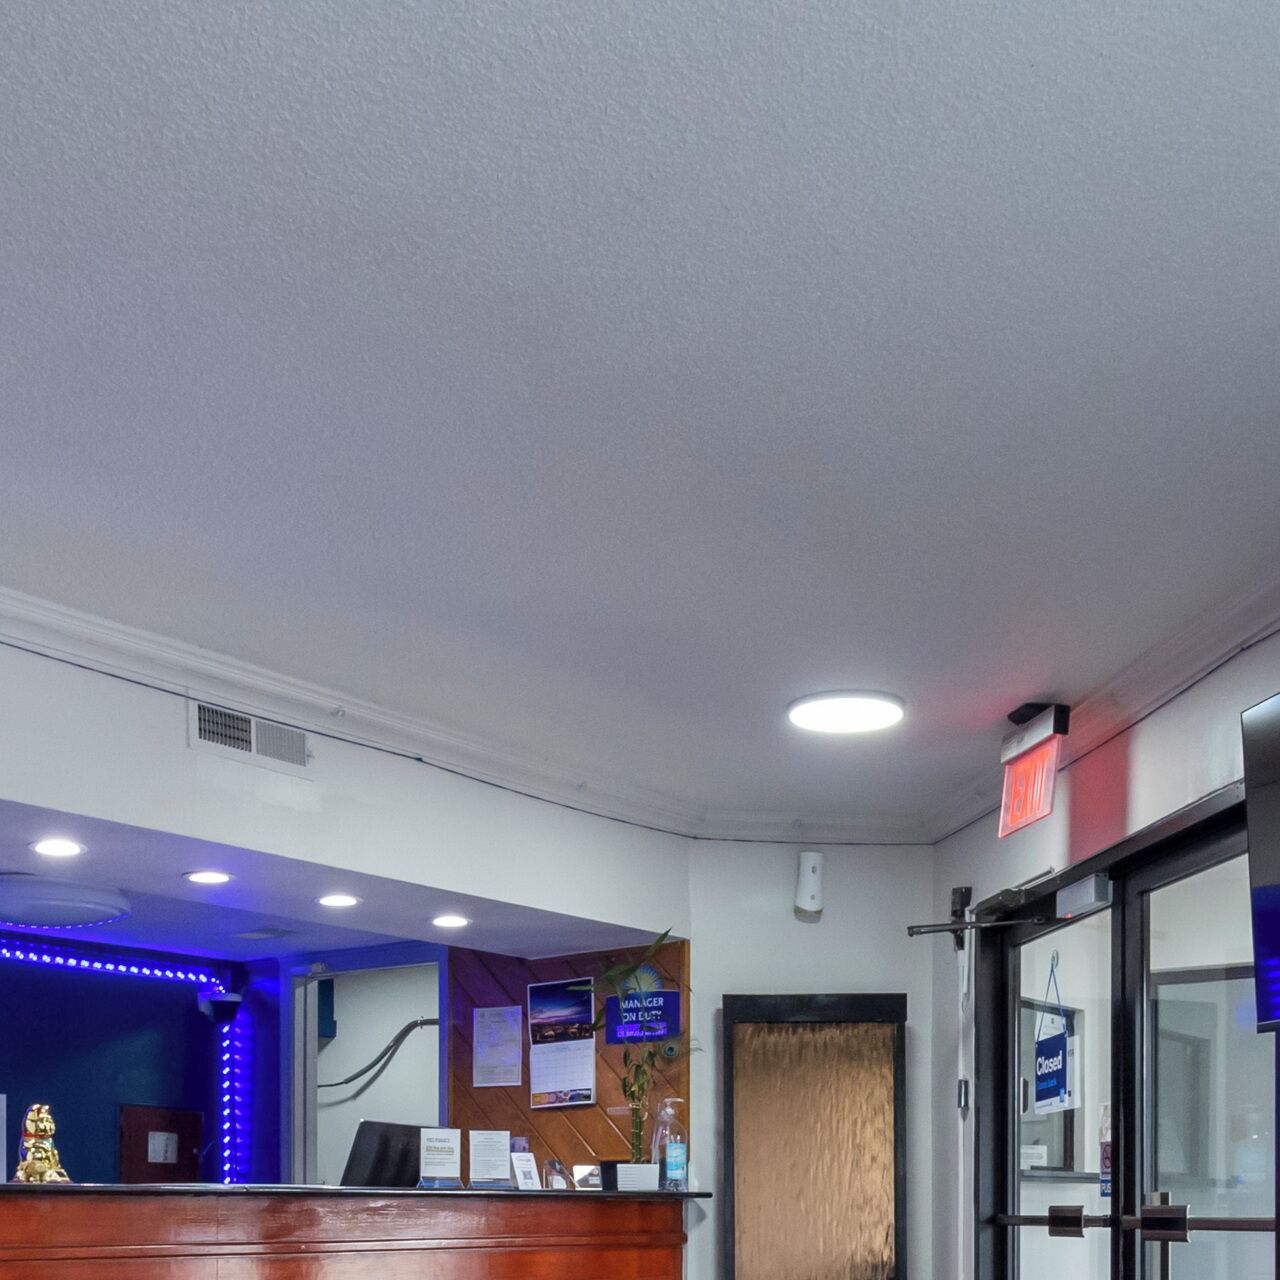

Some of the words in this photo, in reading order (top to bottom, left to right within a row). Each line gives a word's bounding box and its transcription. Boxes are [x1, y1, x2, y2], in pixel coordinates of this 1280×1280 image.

[1009, 747, 1051, 826] EXIT
[622, 997, 664, 1009] MANAGER
[623, 1012, 636, 1022] ON
[1036, 1050, 1063, 1076] Closed
[1102, 1183, 1111, 1193] PUS
